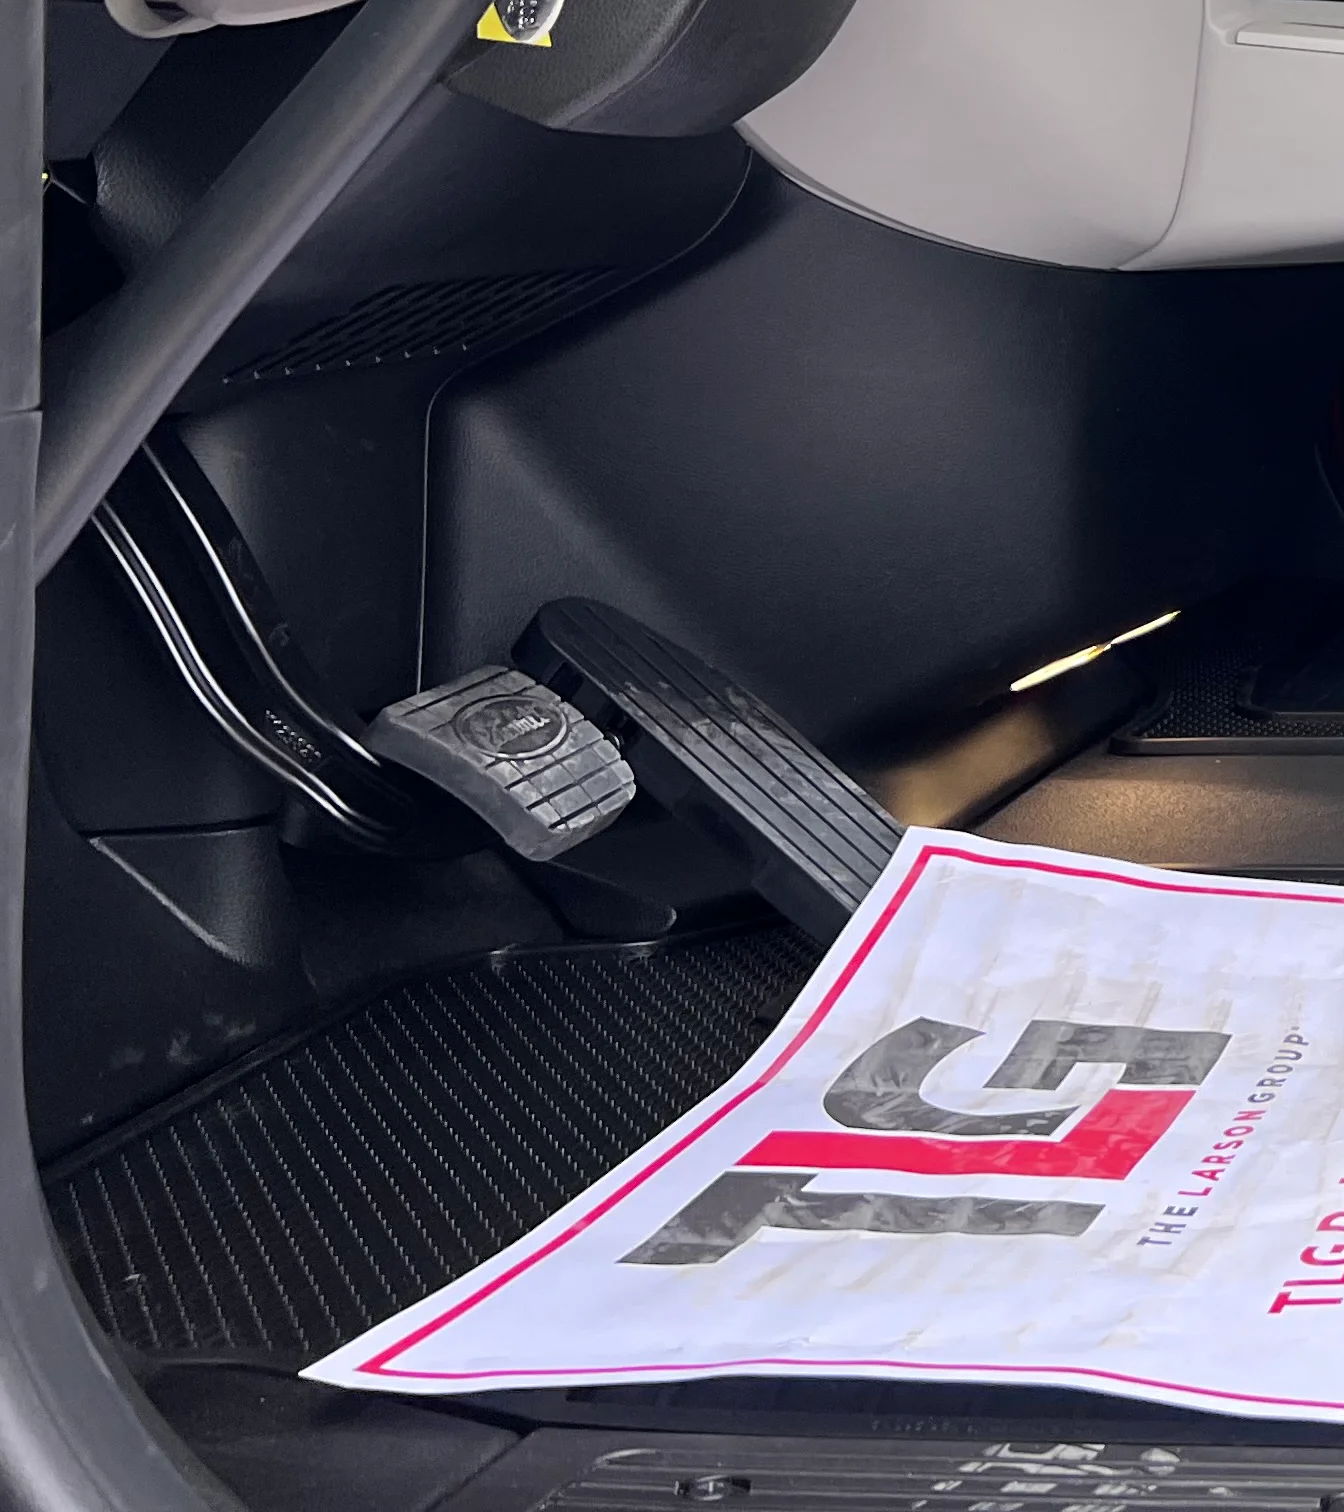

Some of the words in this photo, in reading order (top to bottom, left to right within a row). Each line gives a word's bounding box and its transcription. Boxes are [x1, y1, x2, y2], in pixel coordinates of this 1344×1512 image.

[616, 1015, 1233, 1266] TLG
[1137, 1204, 1199, 1247] THE
[1193, 1108, 1266, 1197] LARSON
[1246, 1033, 1310, 1105] GROUP
